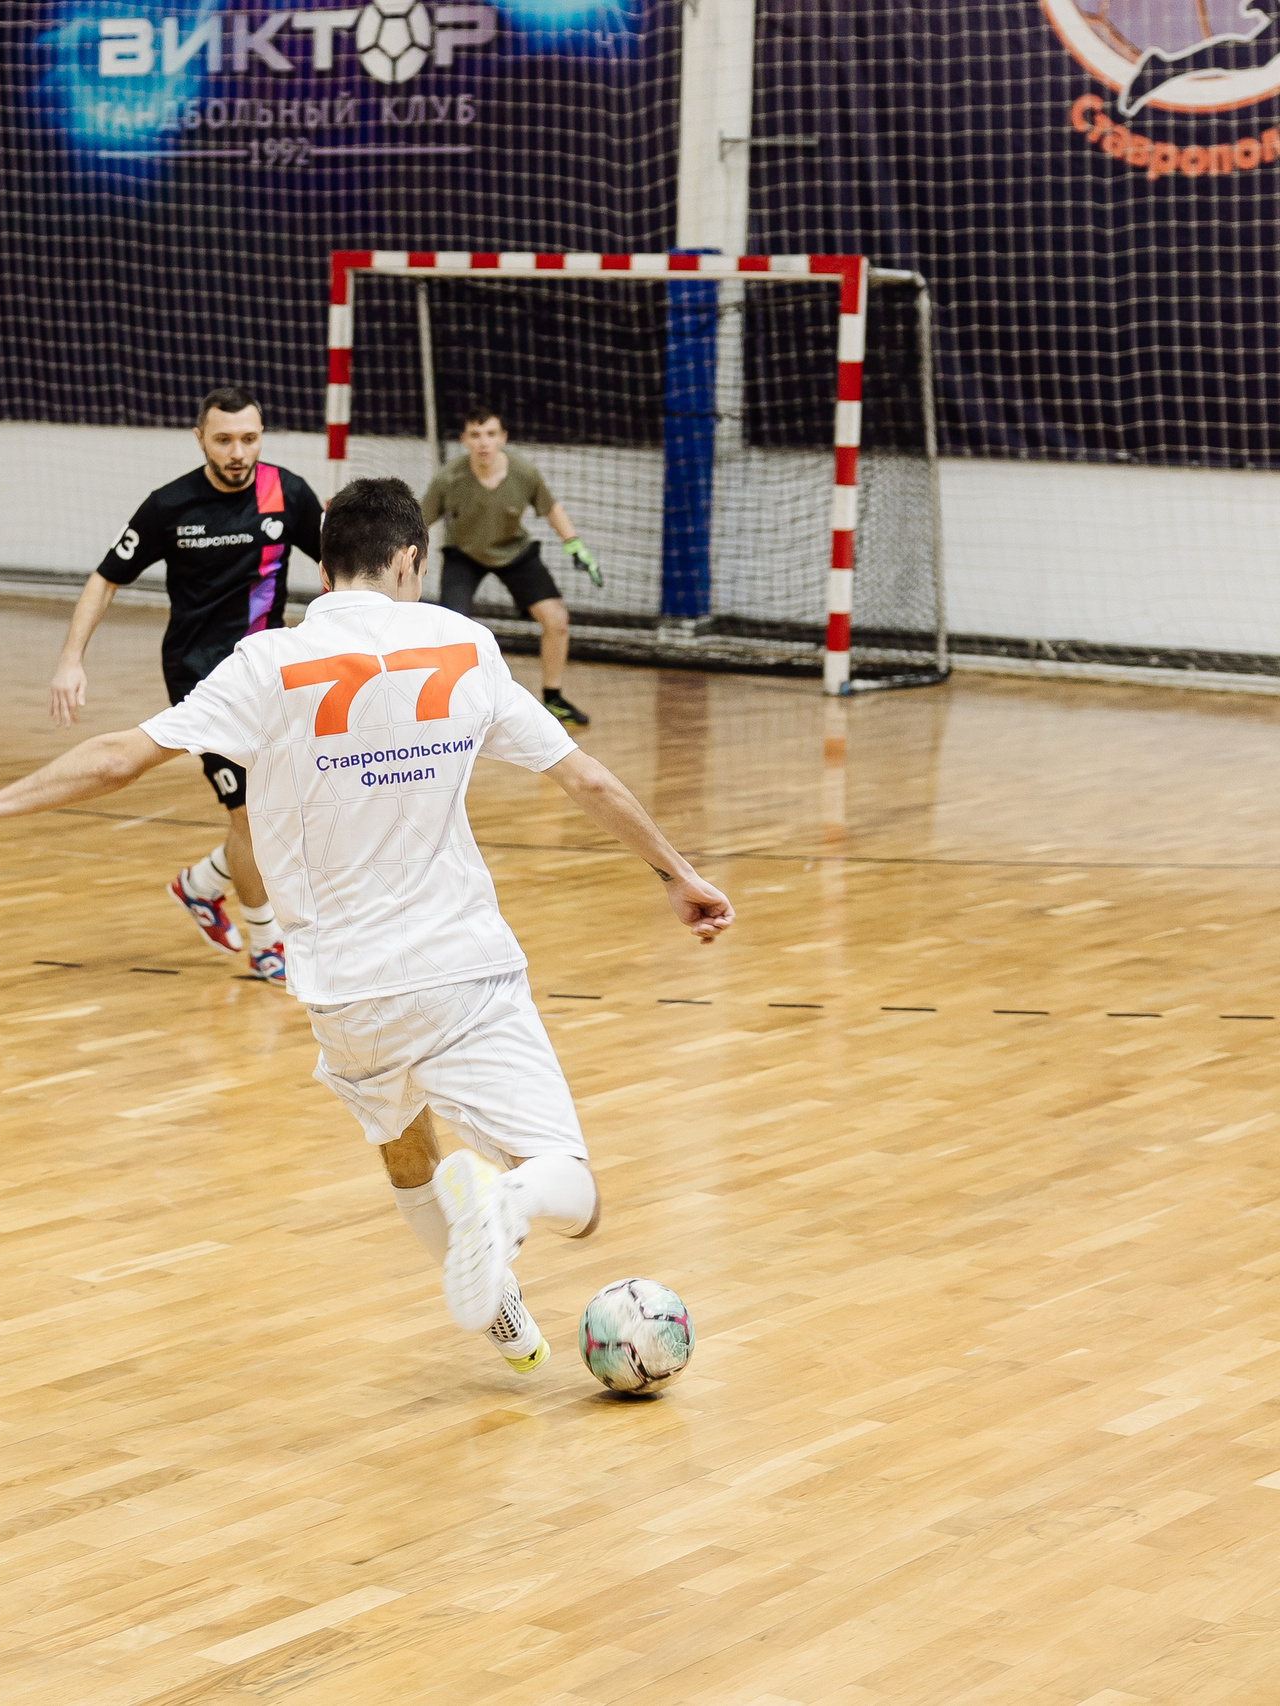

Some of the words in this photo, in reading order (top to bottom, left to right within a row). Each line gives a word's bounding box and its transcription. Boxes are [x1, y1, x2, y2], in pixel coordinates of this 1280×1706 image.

[96, 91, 359, 132] ГАНДБОЛЬНЫЙ
[381, 93, 476, 126] КЛУБ
[248, 137, 312, 167] 1992
[177, 533, 254, 549] СТАВРОПОЛЬ
[279, 643, 479, 738] 77
[315, 735, 474, 772] Ставропольский
[360, 766, 436, 787] Филиал
